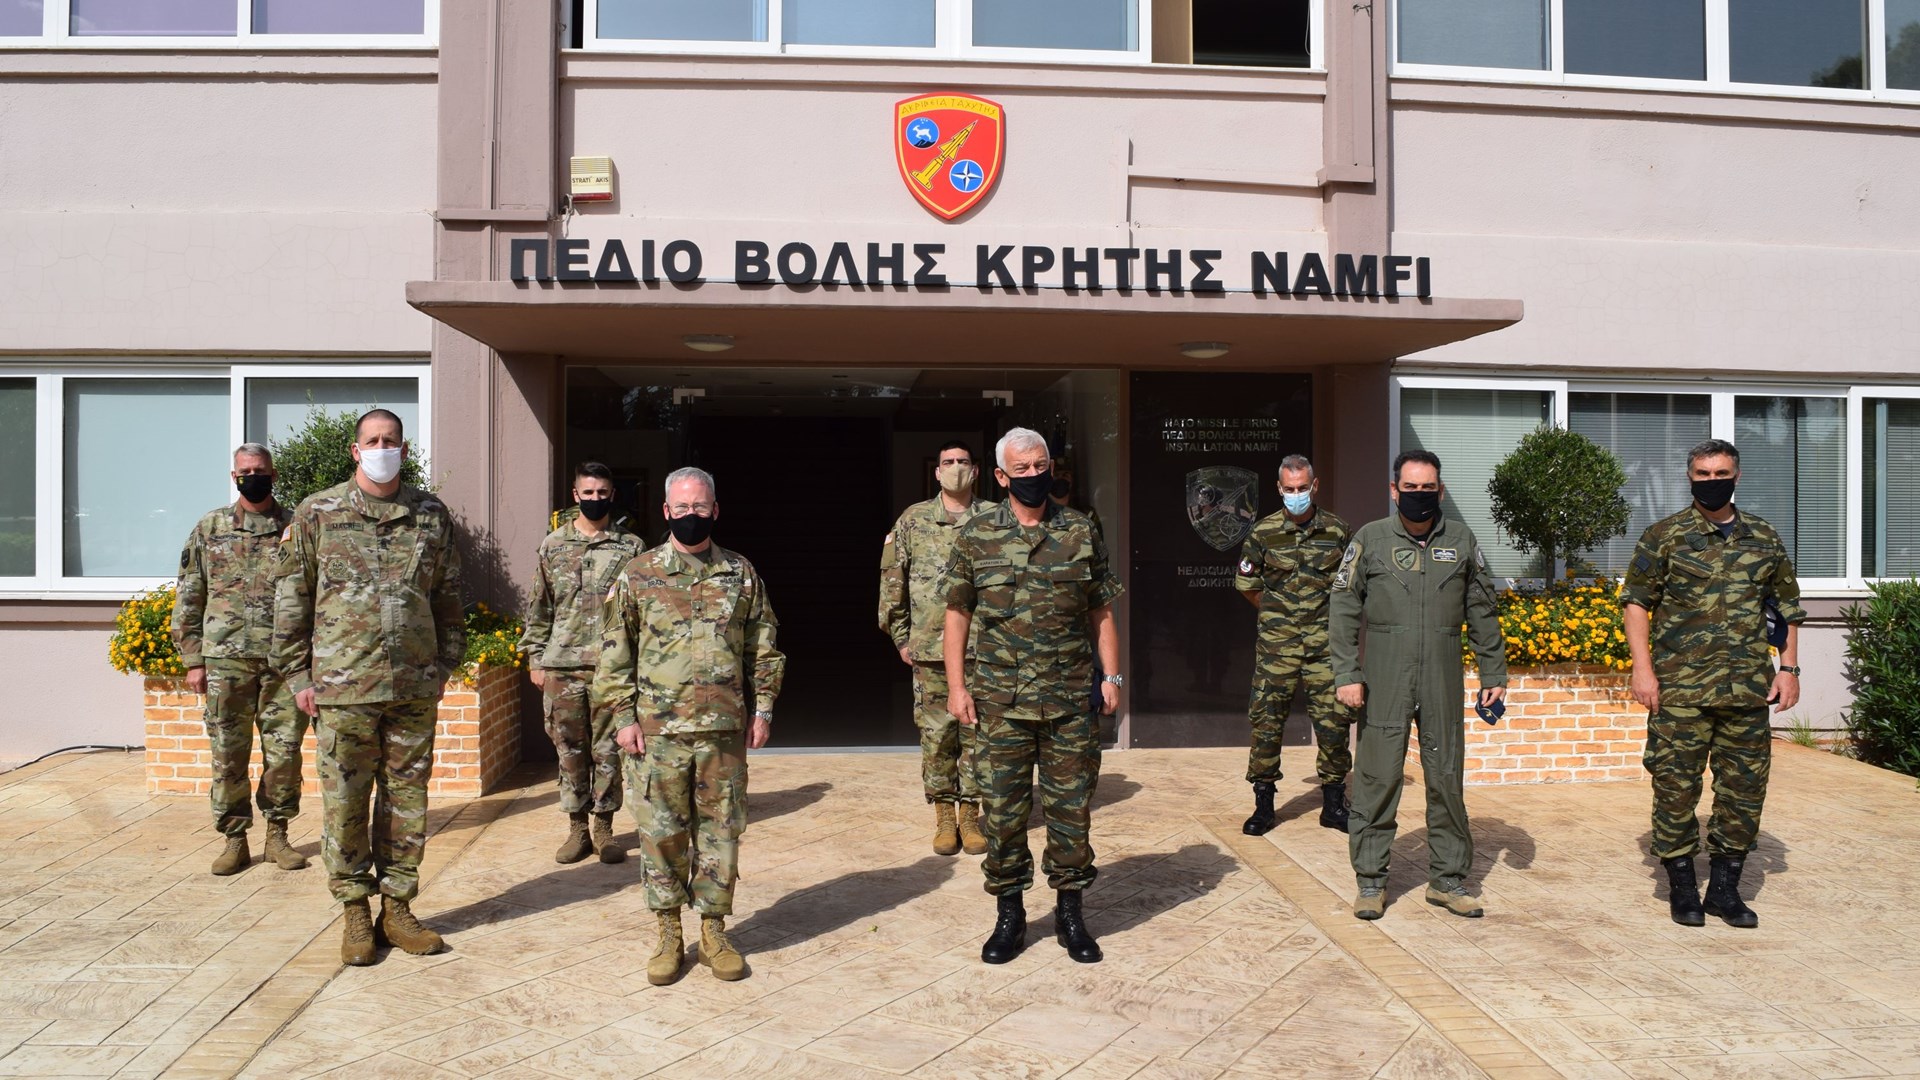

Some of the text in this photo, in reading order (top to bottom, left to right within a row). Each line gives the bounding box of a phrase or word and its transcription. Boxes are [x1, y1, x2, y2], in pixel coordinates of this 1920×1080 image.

[511, 239, 1431, 297] ΠΕΔΙΟ ΒΟΛΗΣ ΚΡΗΤΗΣ NAMFI
[1164, 417, 1279, 429] NATO MISSILE FIRING
[1162, 430, 1281, 441] ΠΕΔΙΟ ΒΟΛΗΣ ΚΡΗΤΗΣ
[1165, 441, 1279, 453] INSTALLATION NAMFI
